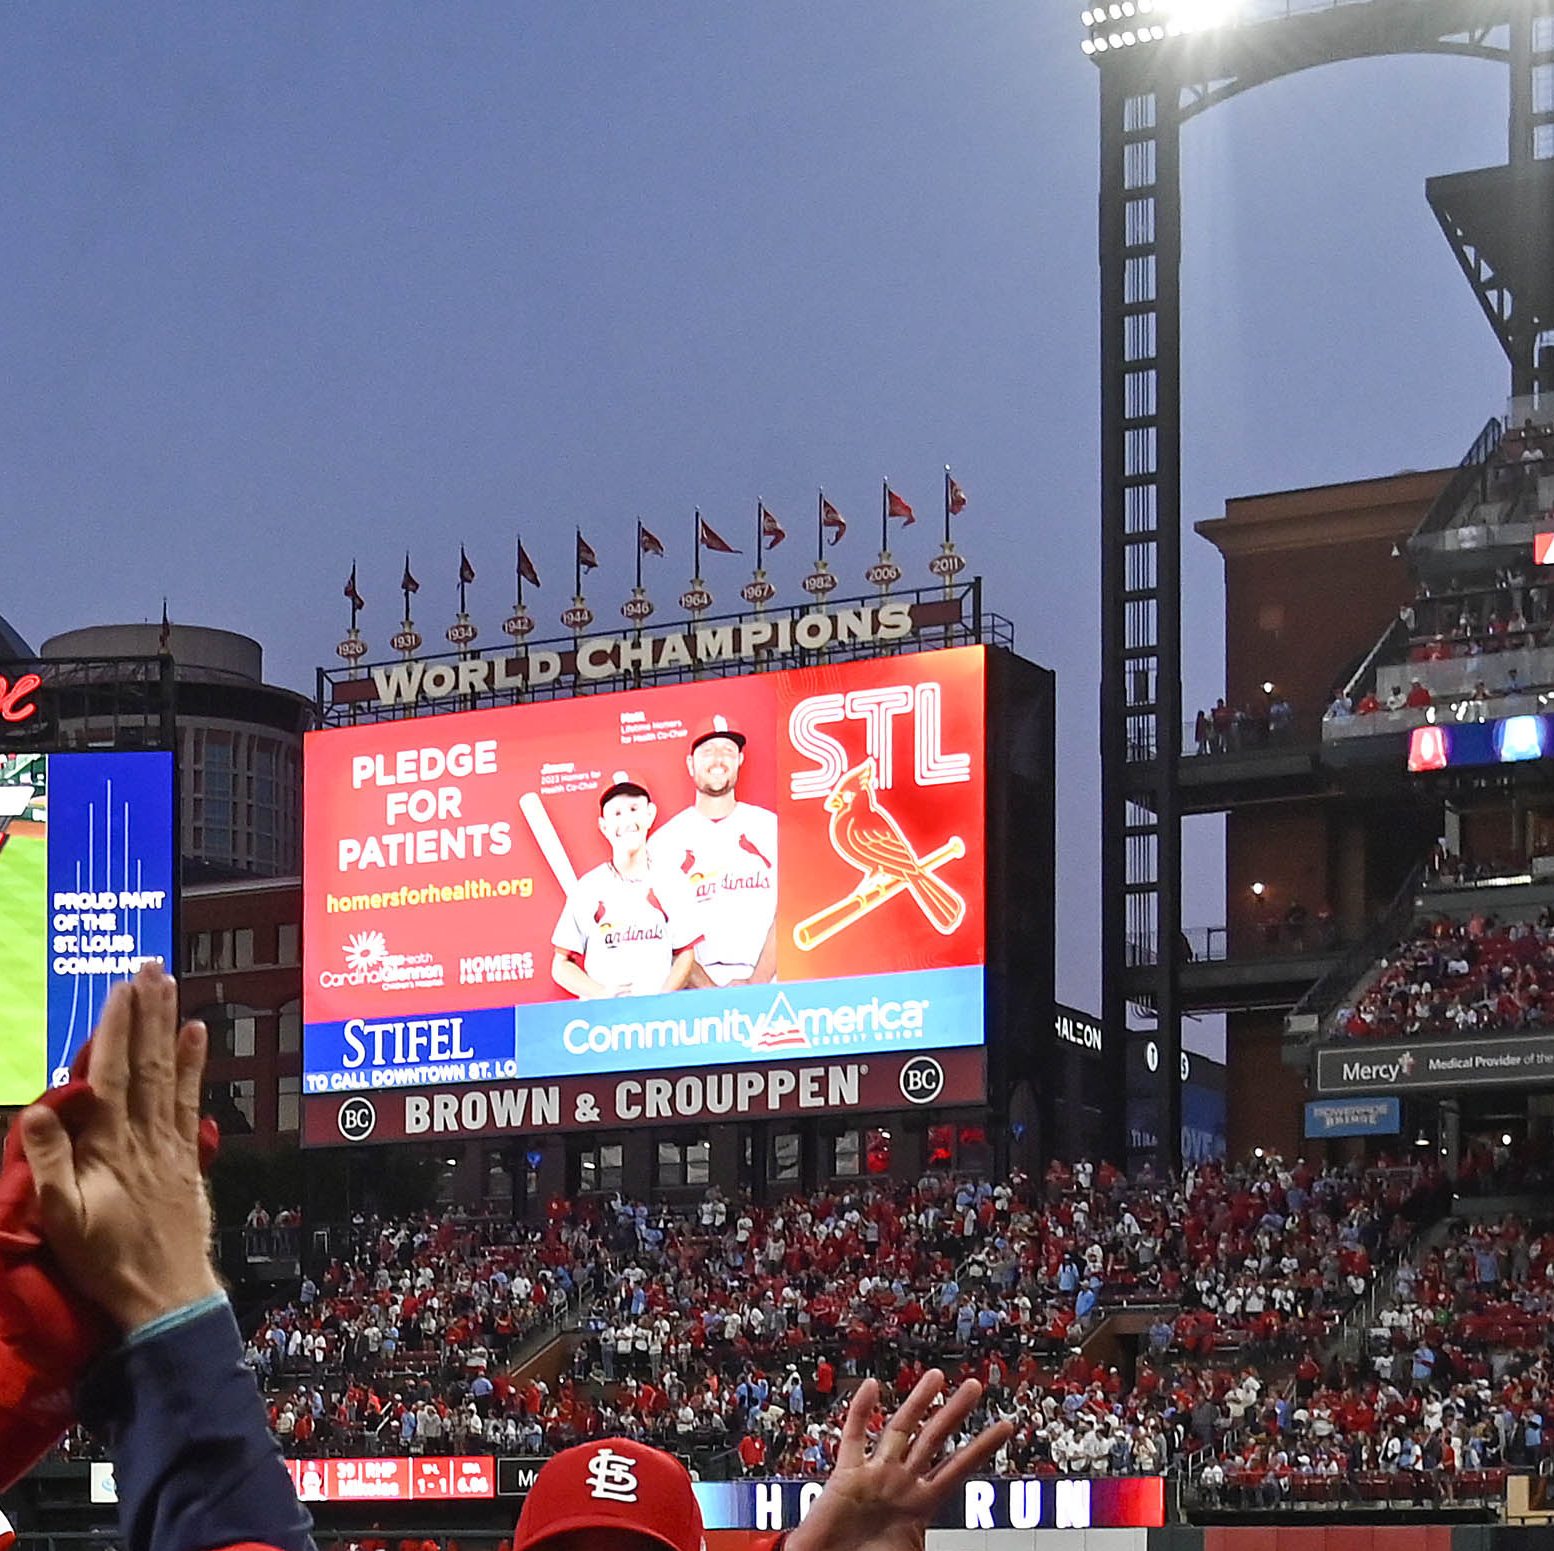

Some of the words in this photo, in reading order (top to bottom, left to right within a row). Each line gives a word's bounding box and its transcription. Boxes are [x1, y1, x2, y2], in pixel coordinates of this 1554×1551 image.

[868, 567, 897, 581] 2006
[933, 558, 960, 572] 2011
[743, 584, 770, 599] 1967
[805, 575, 831, 590] 1982
[623, 602, 650, 615] 1946
[681, 593, 708, 607] 1964
[503, 618, 530, 632] 1942
[562, 611, 589, 625] 1944
[392, 635, 417, 647] 1931
[447, 627, 474, 639] 1934
[338, 643, 364, 655] 1926
[372, 652, 564, 707] WORLD
[576, 603, 913, 680] CHAMPIONS
[788, 682, 971, 800] STL
[352, 740, 498, 789] PLEDGE
[386, 786, 463, 827] FOR
[338, 822, 512, 872] PATIENTS
[53, 892, 118, 911] PROUD
[118, 890, 166, 910] PART
[326, 877, 534, 914] homersforhealth.org
[53, 913, 80, 932] OF
[81, 913, 117, 932] THE
[80, 934, 135, 953] LOUIS
[53, 955, 164, 975] COMMUN
[459, 951, 534, 974] HOMERS
[342, 1018, 475, 1069] STIFEL
[306, 1073, 330, 1092] TO
[331, 1070, 371, 1090] CALL
[371, 1063, 467, 1087] DOWNTOWN
[468, 1061, 492, 1081] ST.
[1342, 1062, 1400, 1082] Mercy
[1428, 1058, 1474, 1072] Medical
[1475, 1054, 1521, 1069] Provider
[344, 1107, 370, 1129] BC
[405, 1086, 561, 1135] BROWN
[574, 1092, 601, 1123] &
[615, 1063, 860, 1121] CROUPPEN
[906, 1067, 938, 1092] BC
[965, 1478, 1092, 1530] RUN
